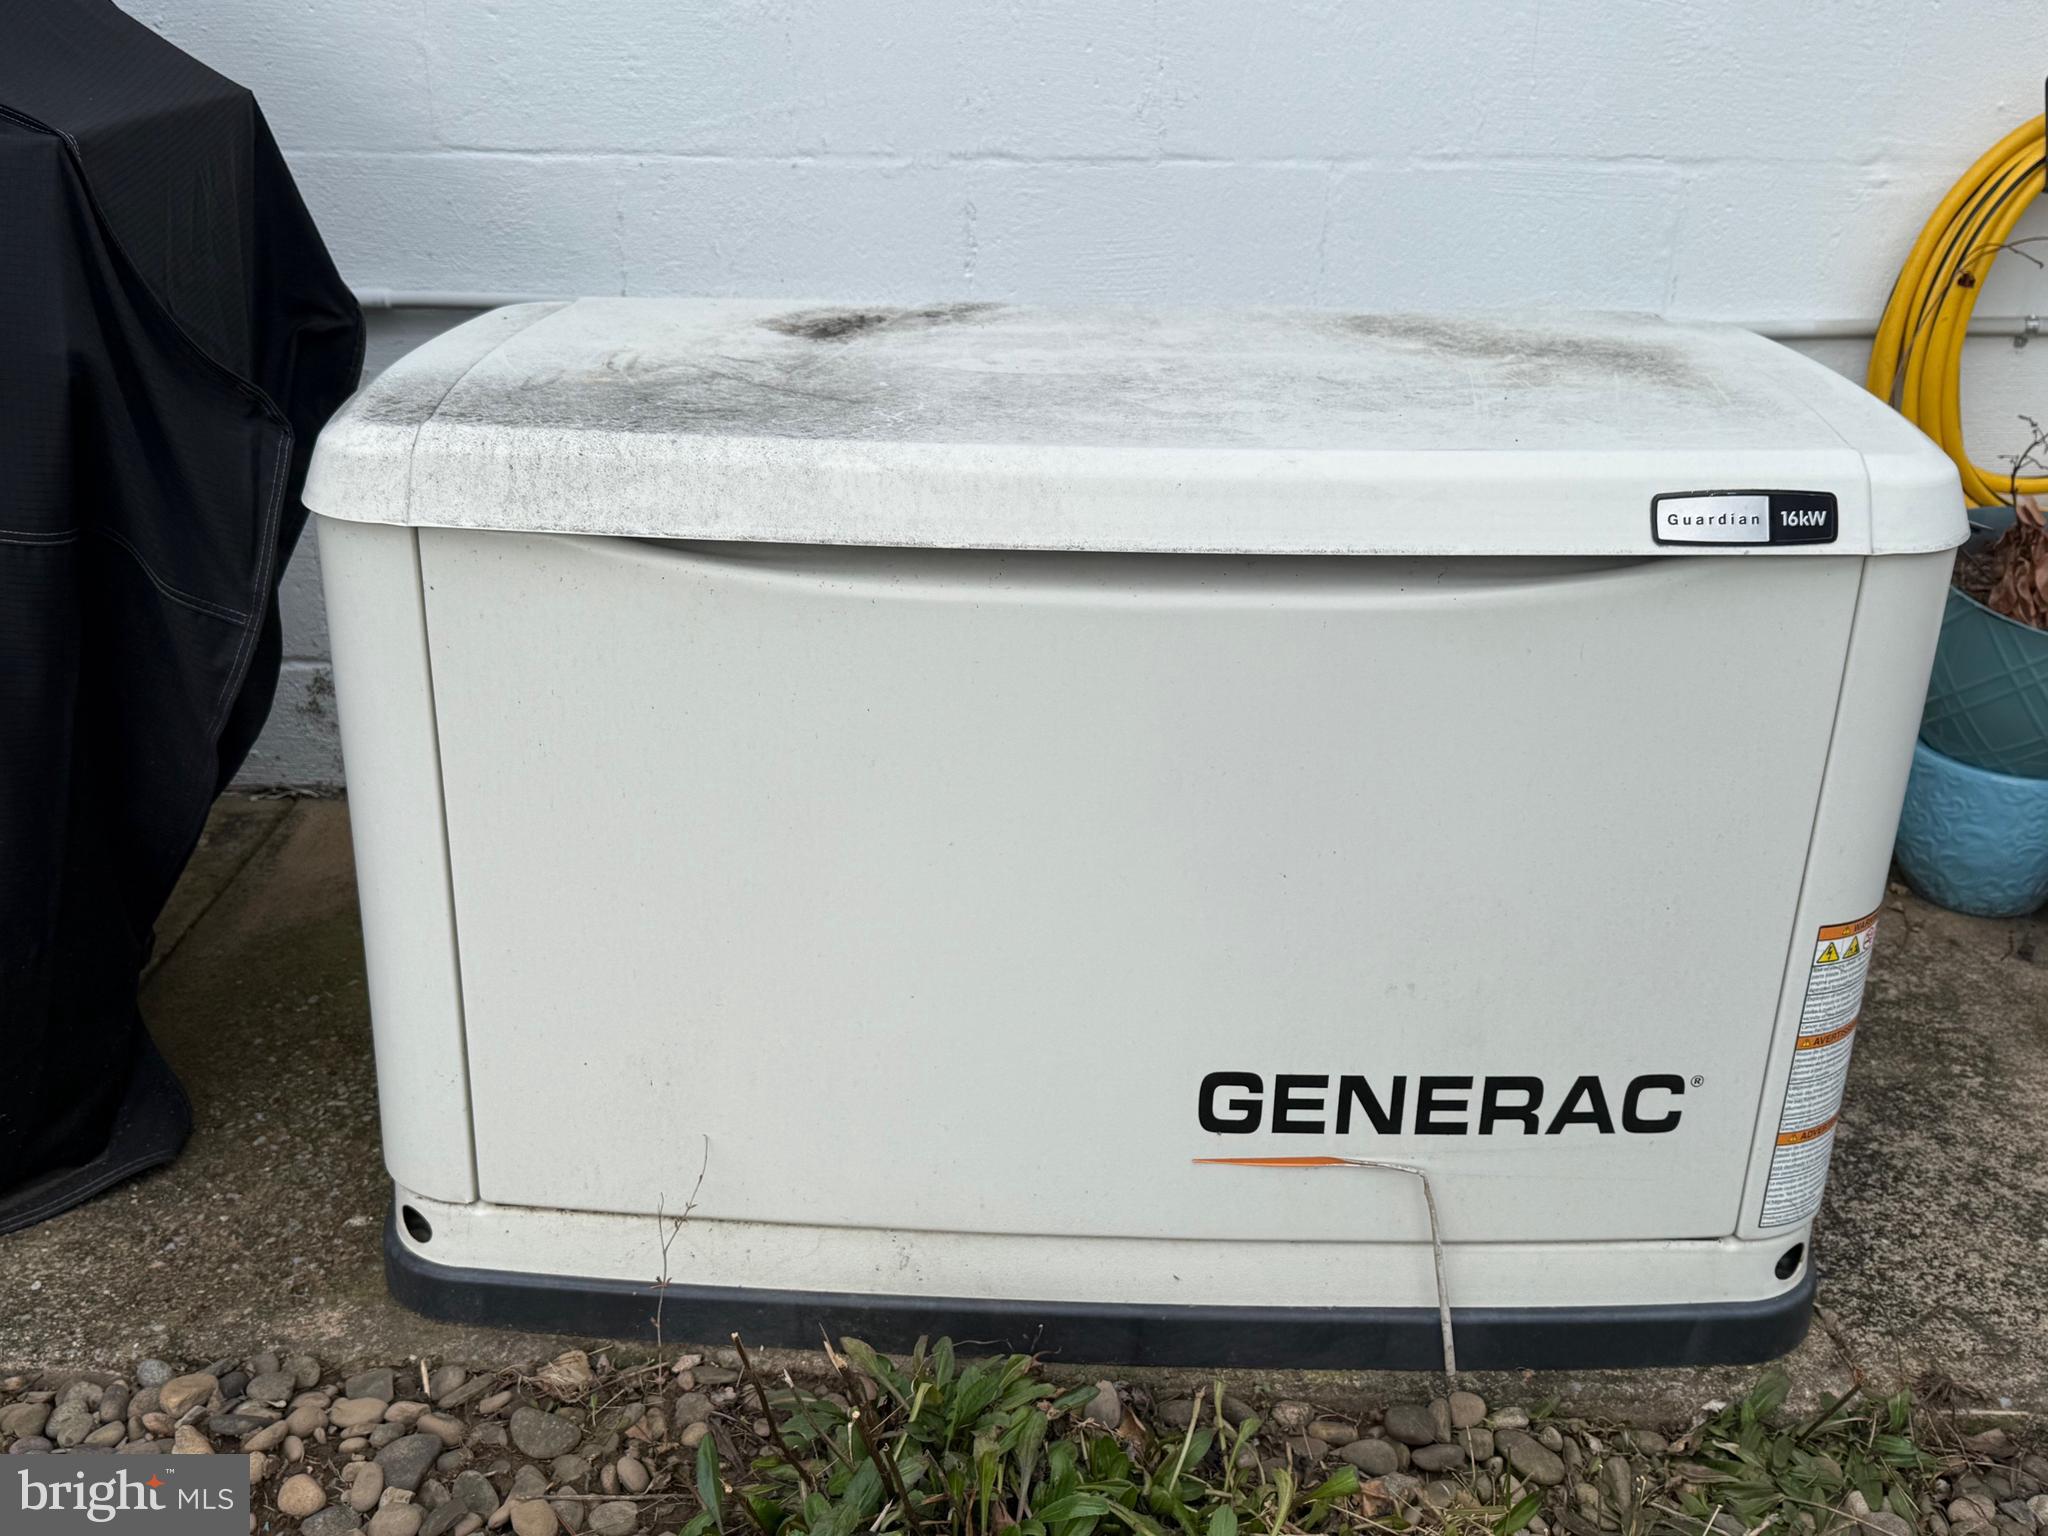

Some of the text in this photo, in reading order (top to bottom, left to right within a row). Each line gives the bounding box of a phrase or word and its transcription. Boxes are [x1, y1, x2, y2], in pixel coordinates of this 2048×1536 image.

[1667, 509, 1827, 527] Guardian 16kW
[1198, 1070, 1686, 1136] GENERAC
